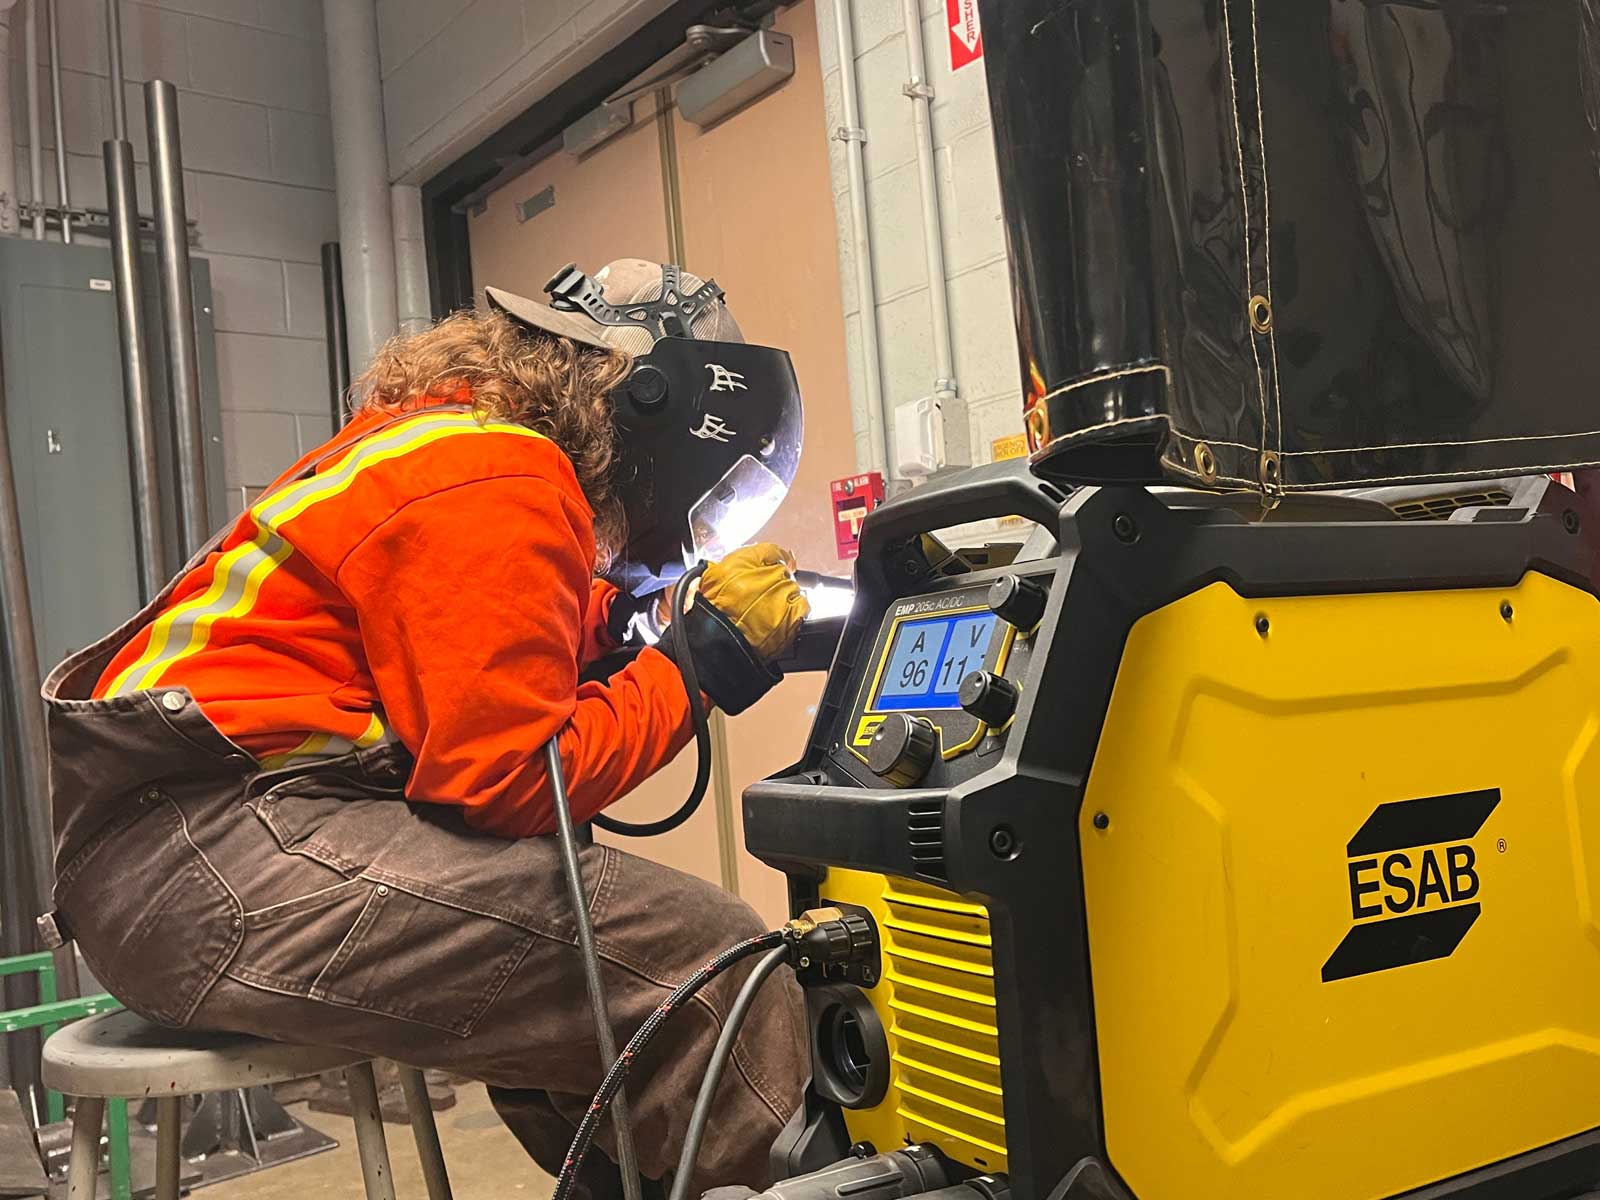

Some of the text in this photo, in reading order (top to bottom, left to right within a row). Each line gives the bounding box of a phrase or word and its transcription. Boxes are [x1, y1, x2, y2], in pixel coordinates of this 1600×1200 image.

[895, 603, 915, 616] EMP
[935, 596, 965, 610] AC/DC
[911, 631, 925, 653] A
[970, 624, 986, 648] V
[900, 660, 928, 688] 96
[1348, 845, 1480, 920] ESAB
